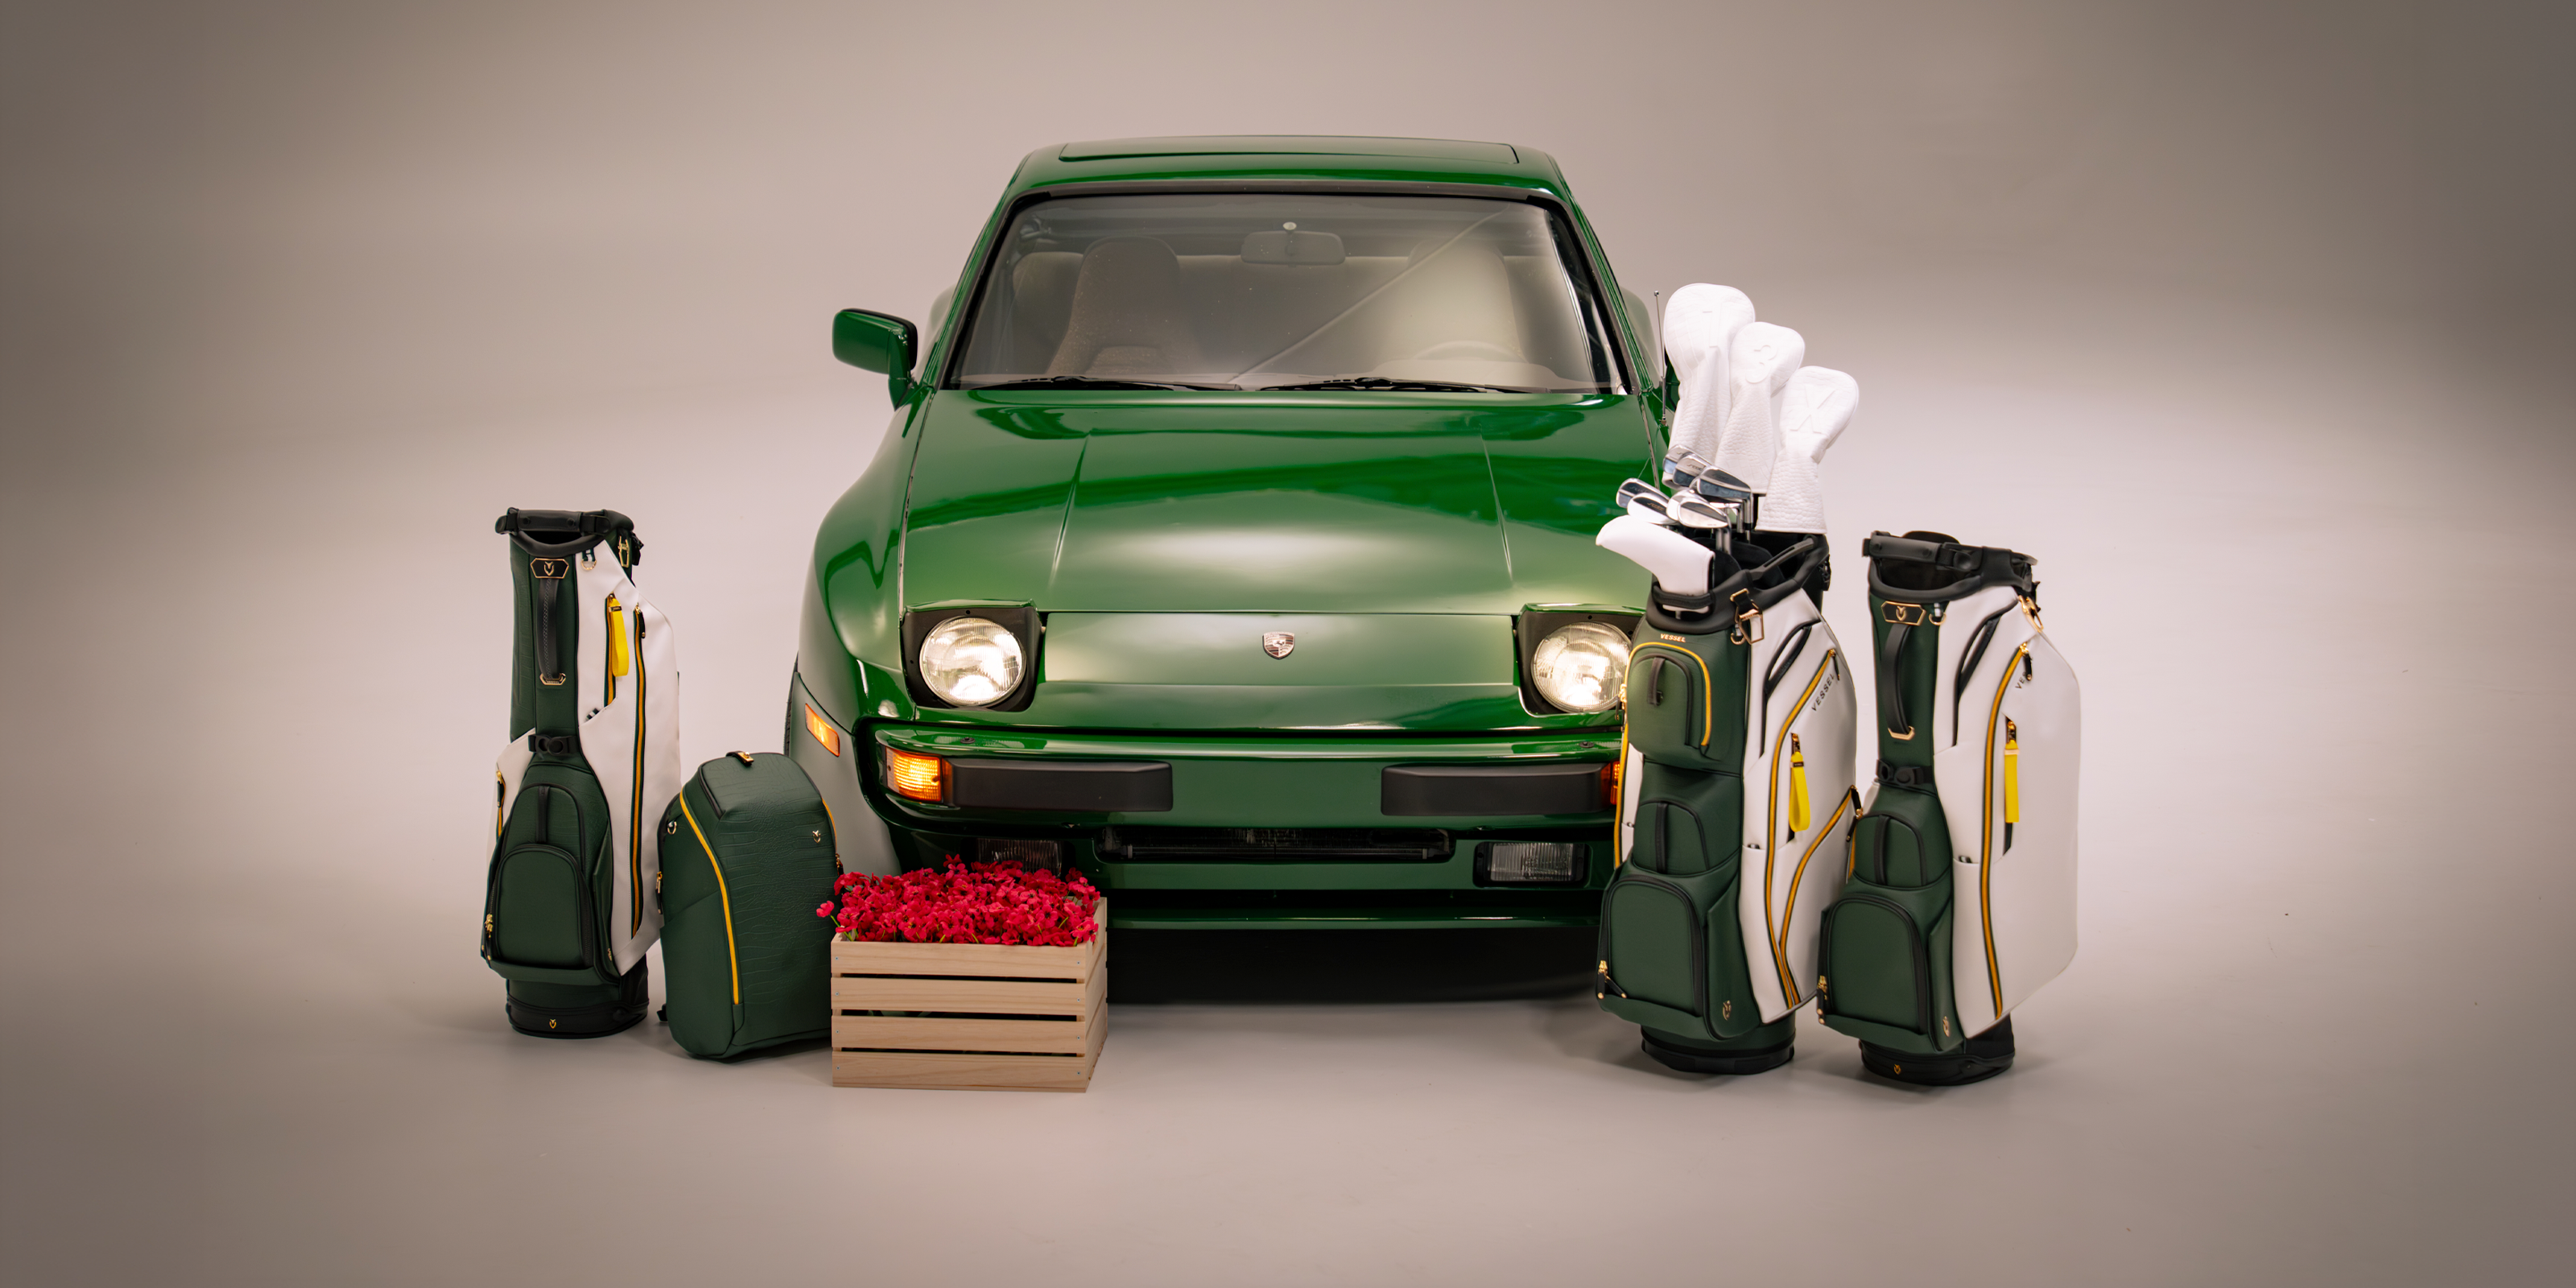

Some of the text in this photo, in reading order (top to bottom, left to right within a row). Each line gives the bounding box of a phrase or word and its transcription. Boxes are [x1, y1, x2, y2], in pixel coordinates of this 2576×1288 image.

[1702, 301, 1723, 348] 1
[1744, 339, 1779, 385] 3
[1790, 384, 1838, 434] X
[1661, 634, 1686, 643] VESSEL
[1811, 673, 1835, 711] VESSEL
